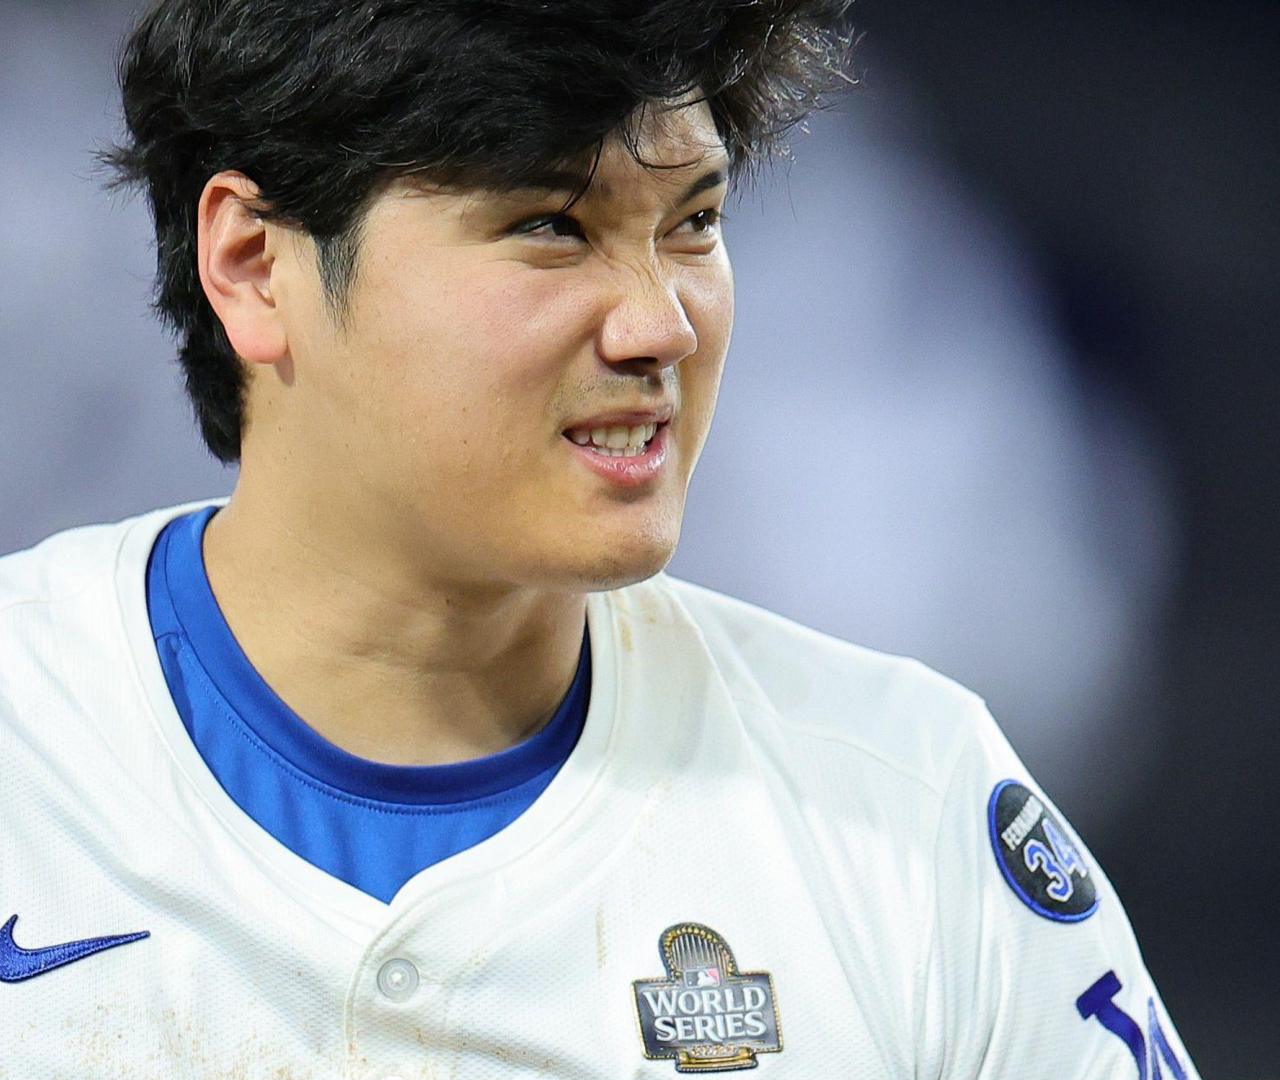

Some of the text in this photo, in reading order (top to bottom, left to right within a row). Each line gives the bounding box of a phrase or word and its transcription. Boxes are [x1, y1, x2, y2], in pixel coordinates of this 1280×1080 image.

[1024, 817, 1087, 902] 34
[642, 987, 767, 1017] WORLD
[654, 1012, 767, 1042] SERIES
